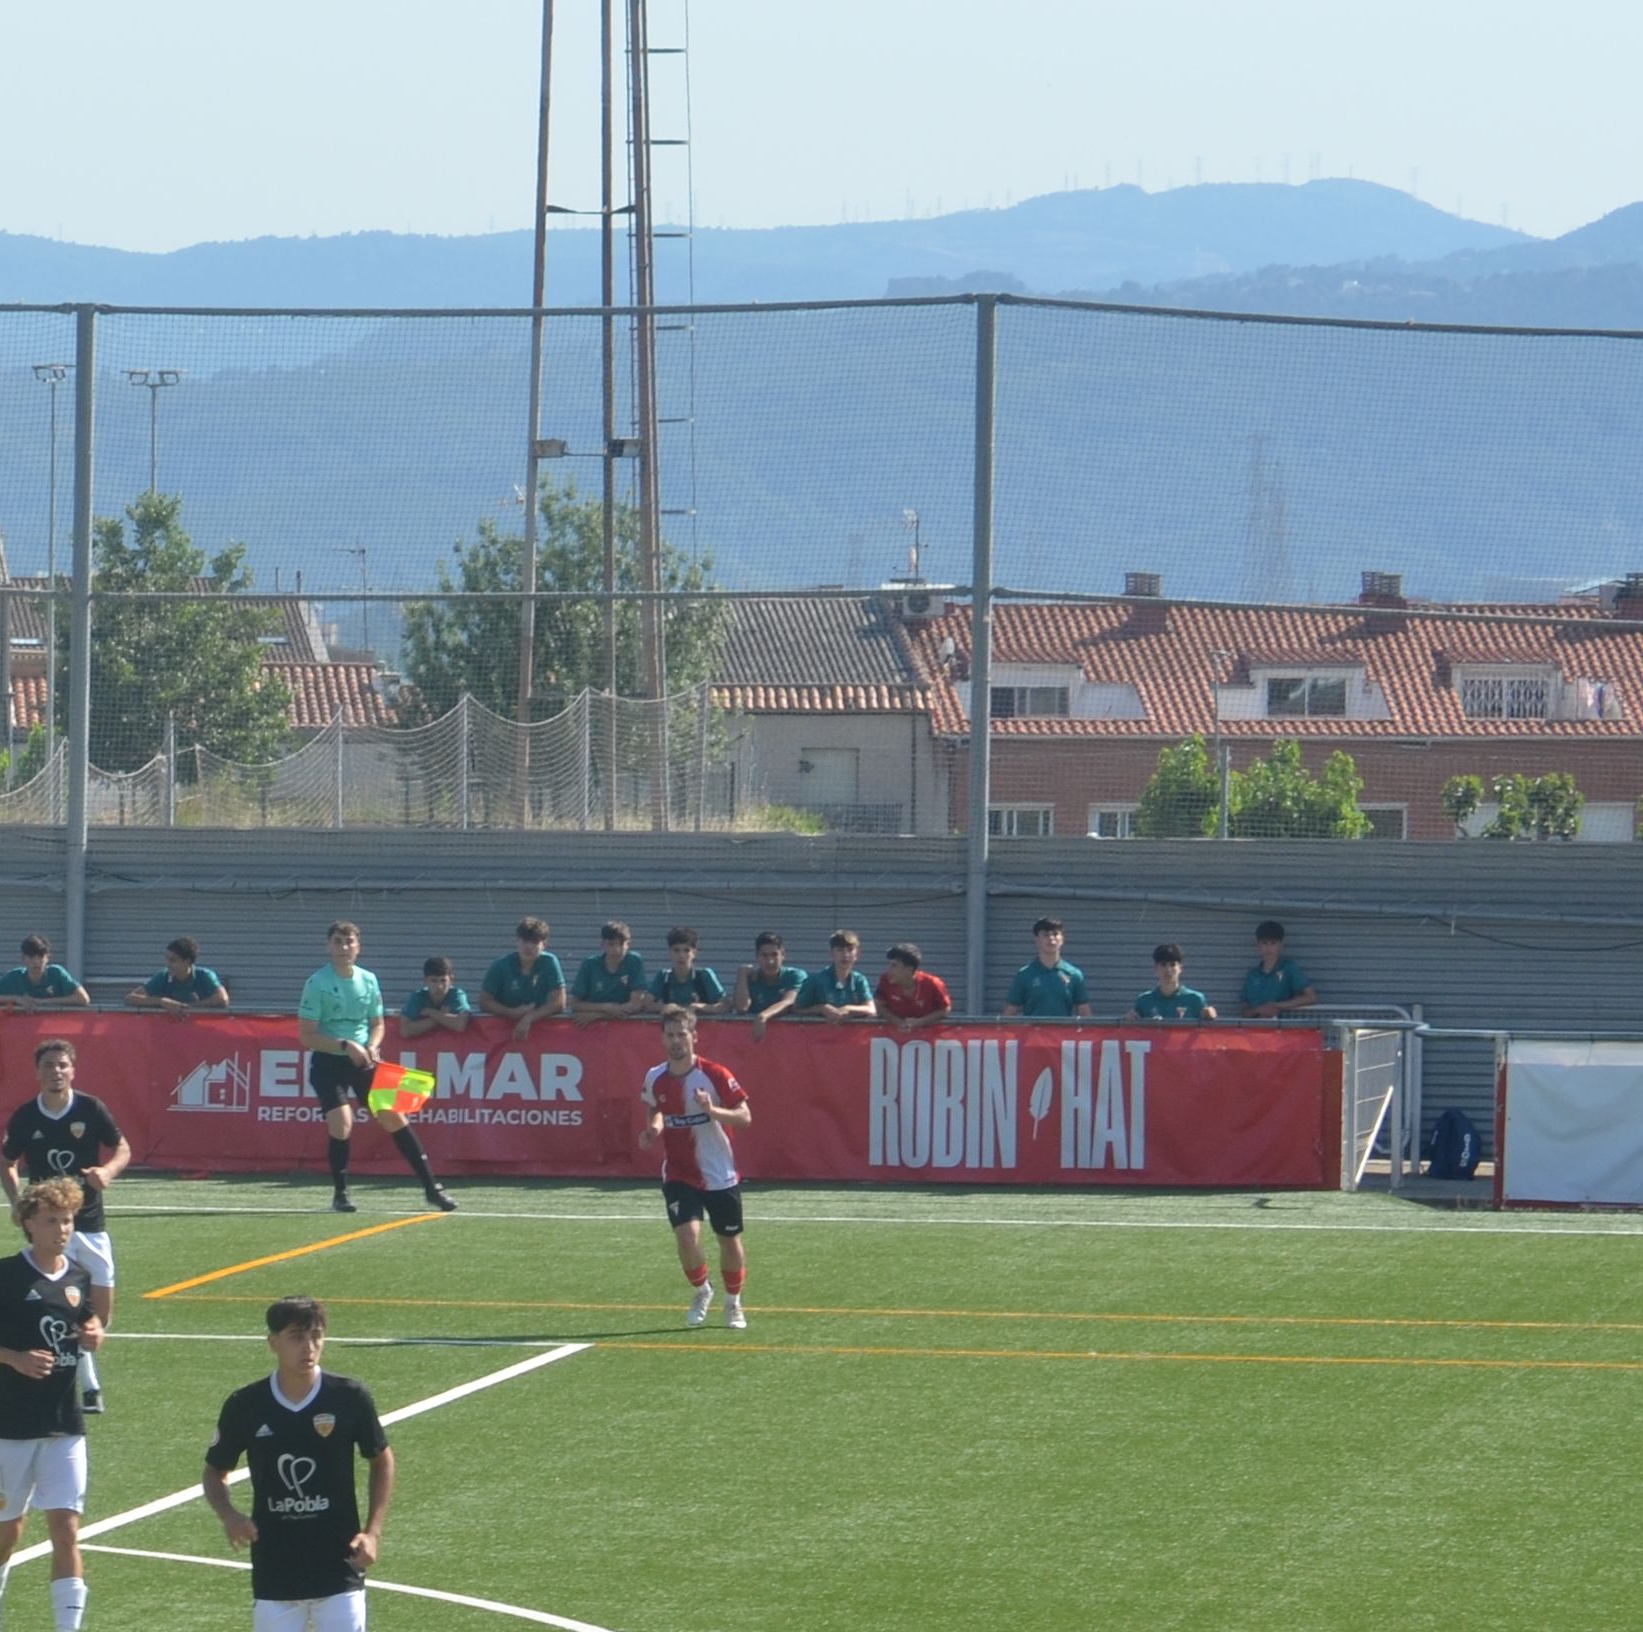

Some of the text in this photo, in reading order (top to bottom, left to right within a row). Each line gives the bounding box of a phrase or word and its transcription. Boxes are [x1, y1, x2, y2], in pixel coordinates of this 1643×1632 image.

[869, 1037, 1151, 1169] ROBIN HAT
[268, 1495, 329, 1513] LaPobla
